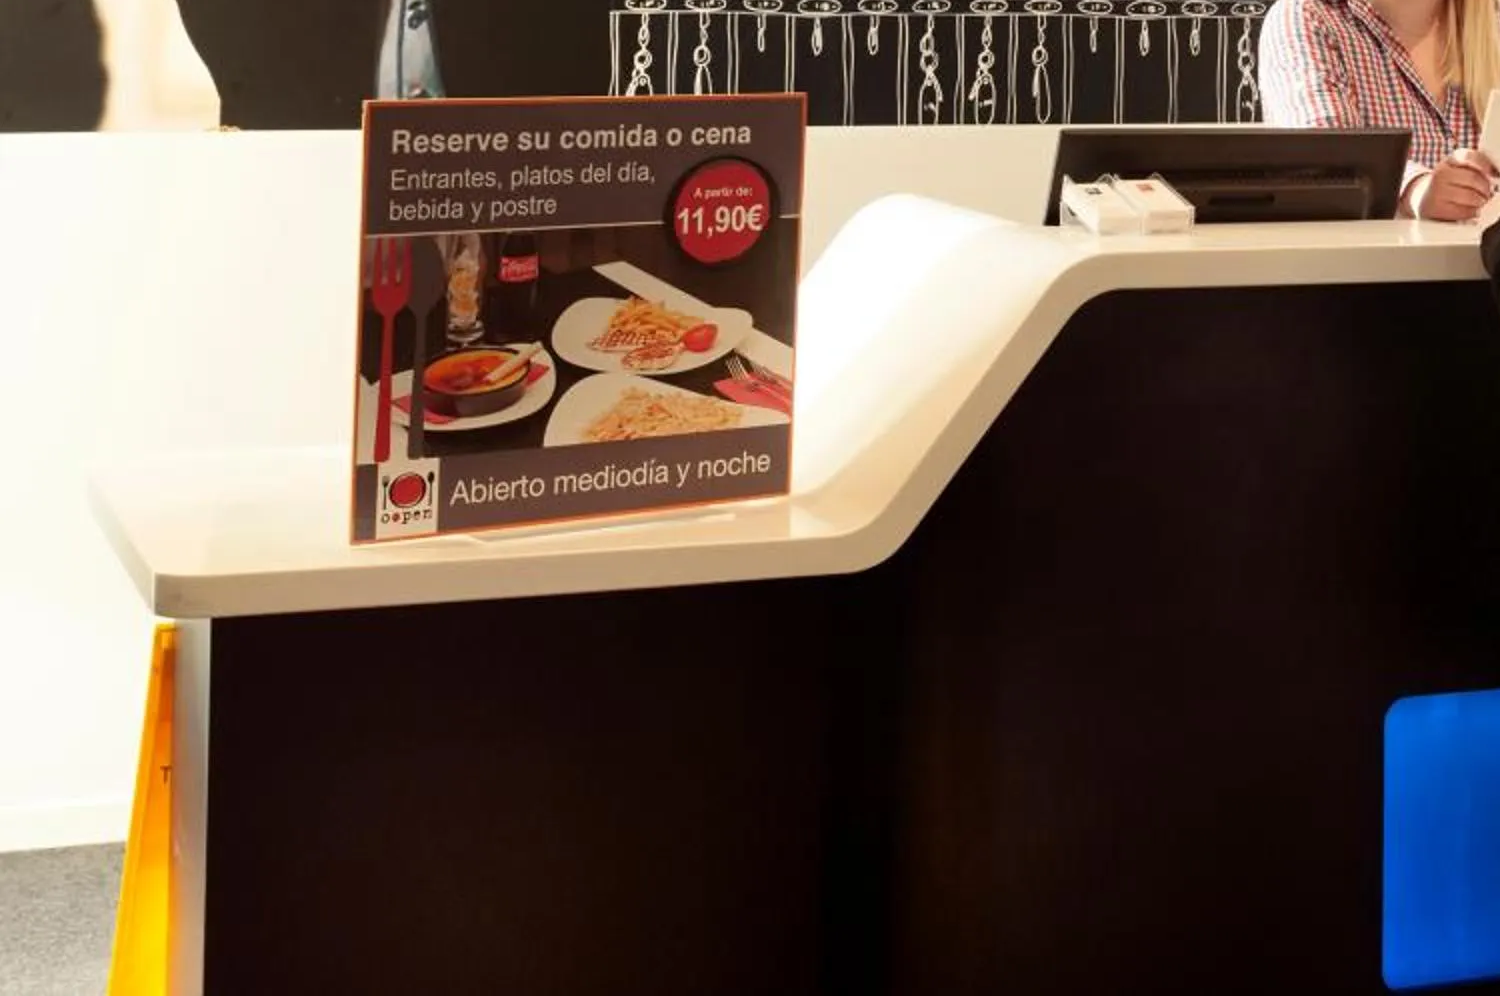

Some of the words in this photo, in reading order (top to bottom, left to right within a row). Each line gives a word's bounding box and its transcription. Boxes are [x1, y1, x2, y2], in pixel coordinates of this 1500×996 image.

[391, 129, 508, 155] Reserve
[517, 130, 550, 151] su
[559, 123, 658, 149] comida
[666, 128, 683, 147] o
[690, 123, 752, 146] cena
[390, 167, 502, 193] Entrantes,
[510, 164, 575, 190] platos
[580, 162, 612, 185] del
[617, 160, 656, 185] día,
[389, 197, 464, 222] bebida
[469, 202, 486, 224] y
[489, 195, 559, 222] postre
[693, 187, 703, 199] A
[704, 186, 734, 201] partir
[735, 186, 754, 197] de:
[676, 203, 765, 239] 11,90€
[449, 475, 546, 506] Abierto
[553, 459, 670, 495] mediodía
[675, 463, 693, 489] y
[696, 451, 772, 481] noche
